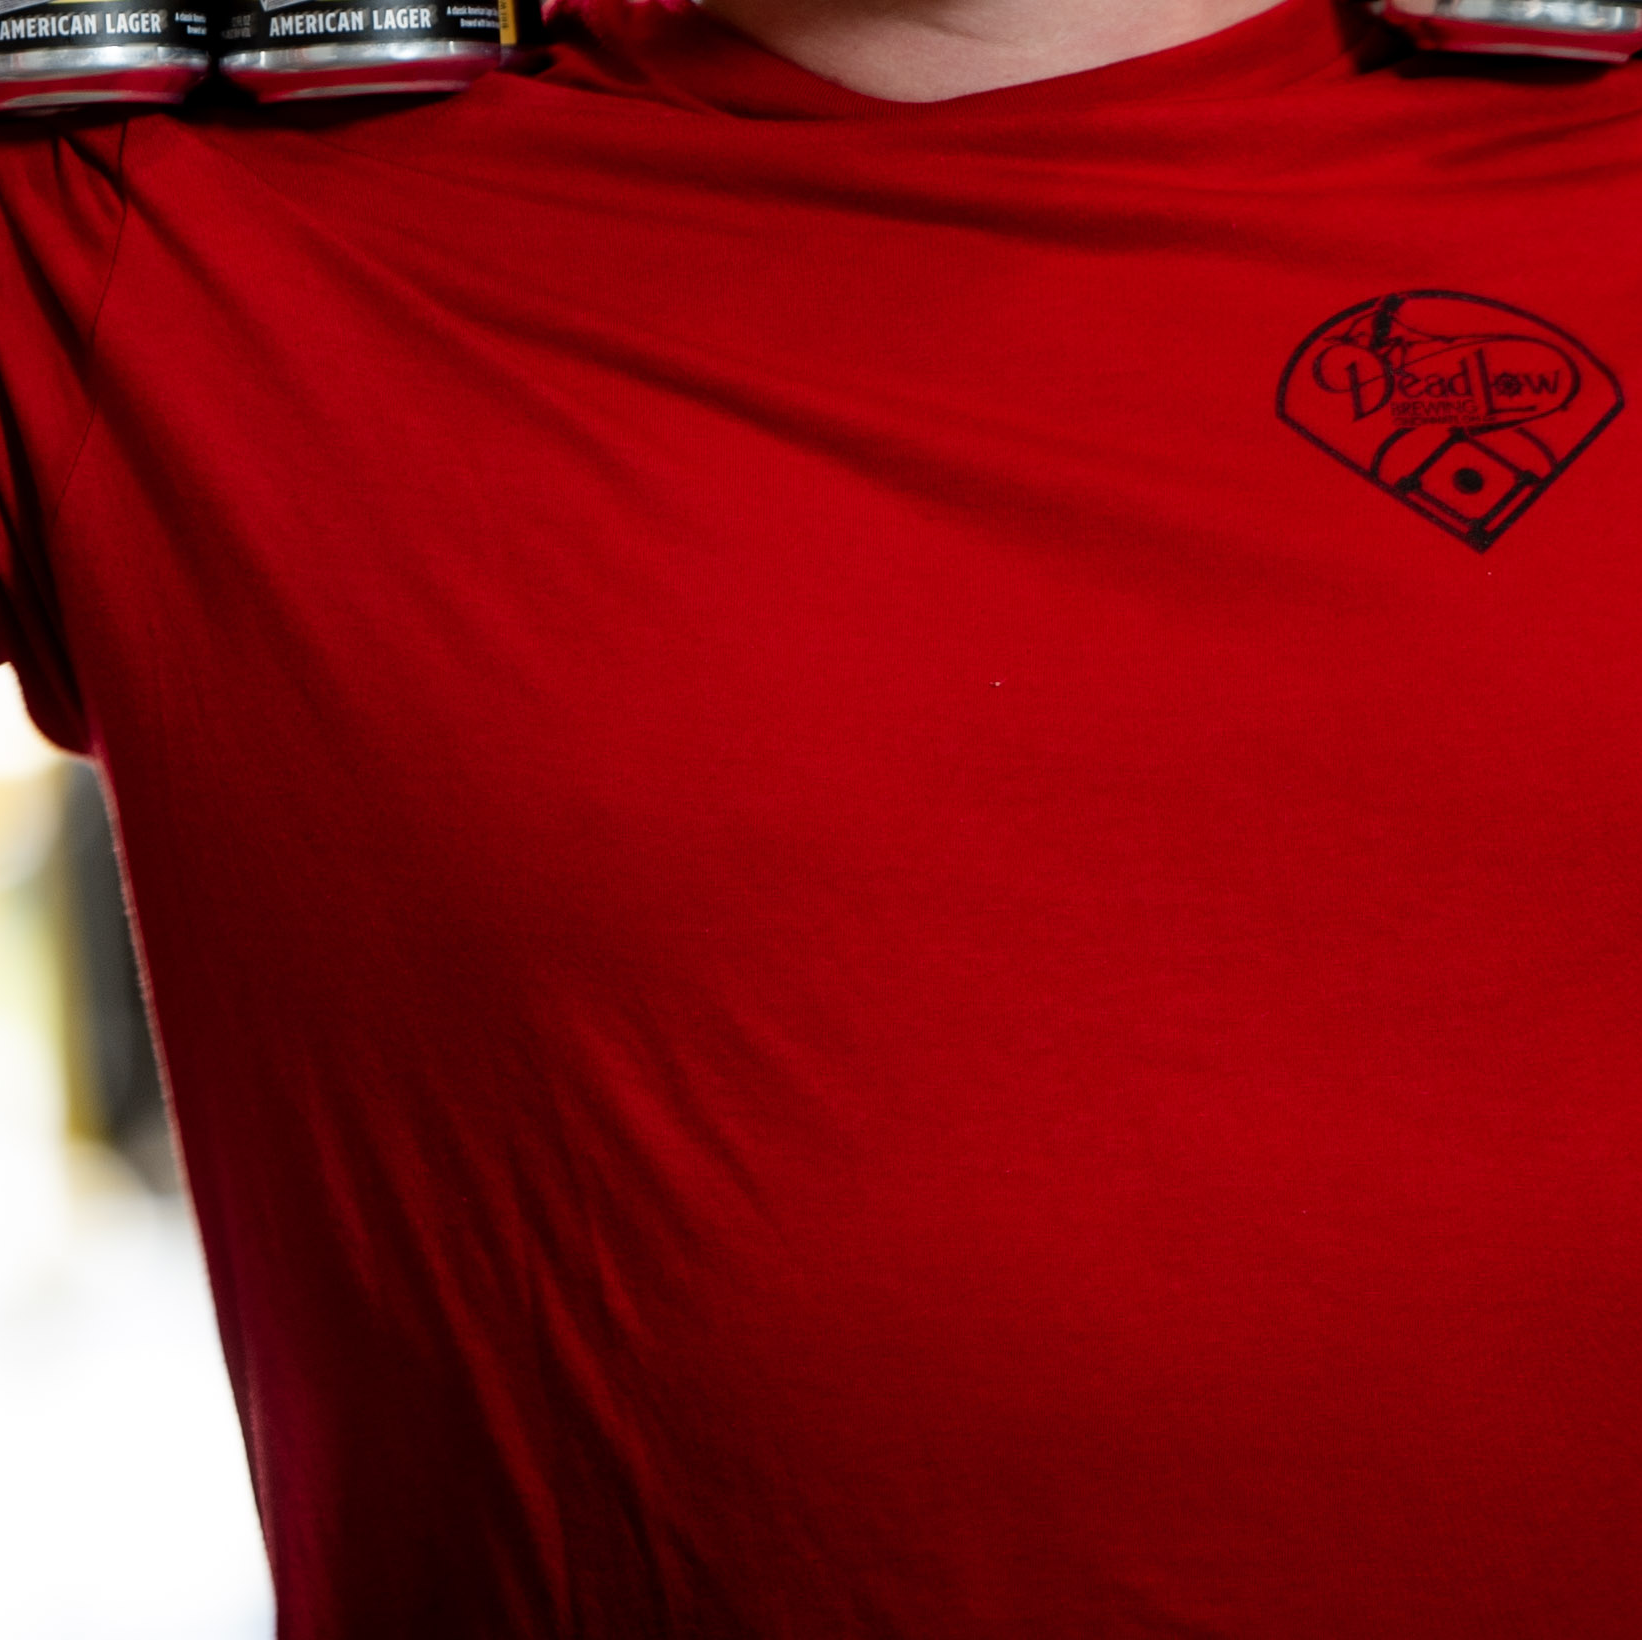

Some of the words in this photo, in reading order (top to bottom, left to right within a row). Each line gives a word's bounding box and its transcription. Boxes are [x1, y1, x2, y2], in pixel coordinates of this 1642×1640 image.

[0, 14, 96, 41] AMERICAN
[106, 12, 161, 34] LAGER
[269, 12, 364, 37] AMERICAN
[372, 8, 431, 31] LAGER
[1313, 343, 1475, 422] Dead
[1474, 348, 1560, 418] Low
[1390, 400, 1478, 415] BREWING
